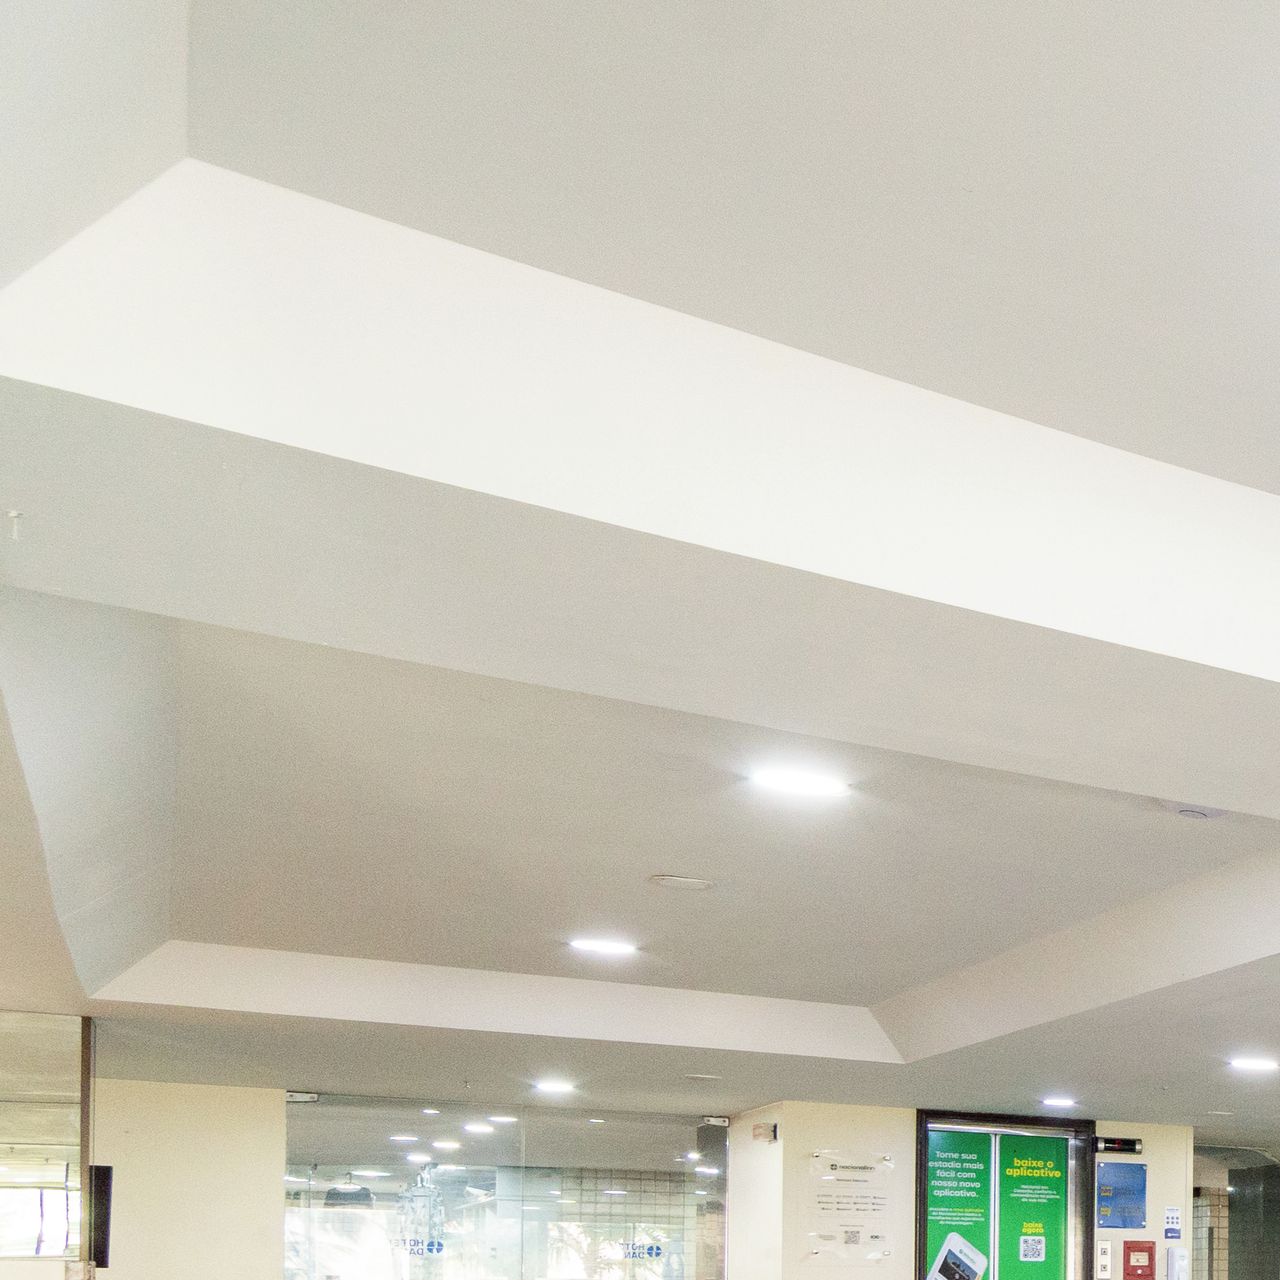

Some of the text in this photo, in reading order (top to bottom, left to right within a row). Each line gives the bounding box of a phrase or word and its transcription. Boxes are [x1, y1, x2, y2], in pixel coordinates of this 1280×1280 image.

[961, 1152, 977, 1160] sua
[928, 1160, 985, 1170] estadia mais
[1013, 1157, 1044, 1168] baixe
[936, 1169, 976, 1179] fácil com
[1005, 1167, 1062, 1178] aplicativo
[931, 1180, 958, 1188] nosso
